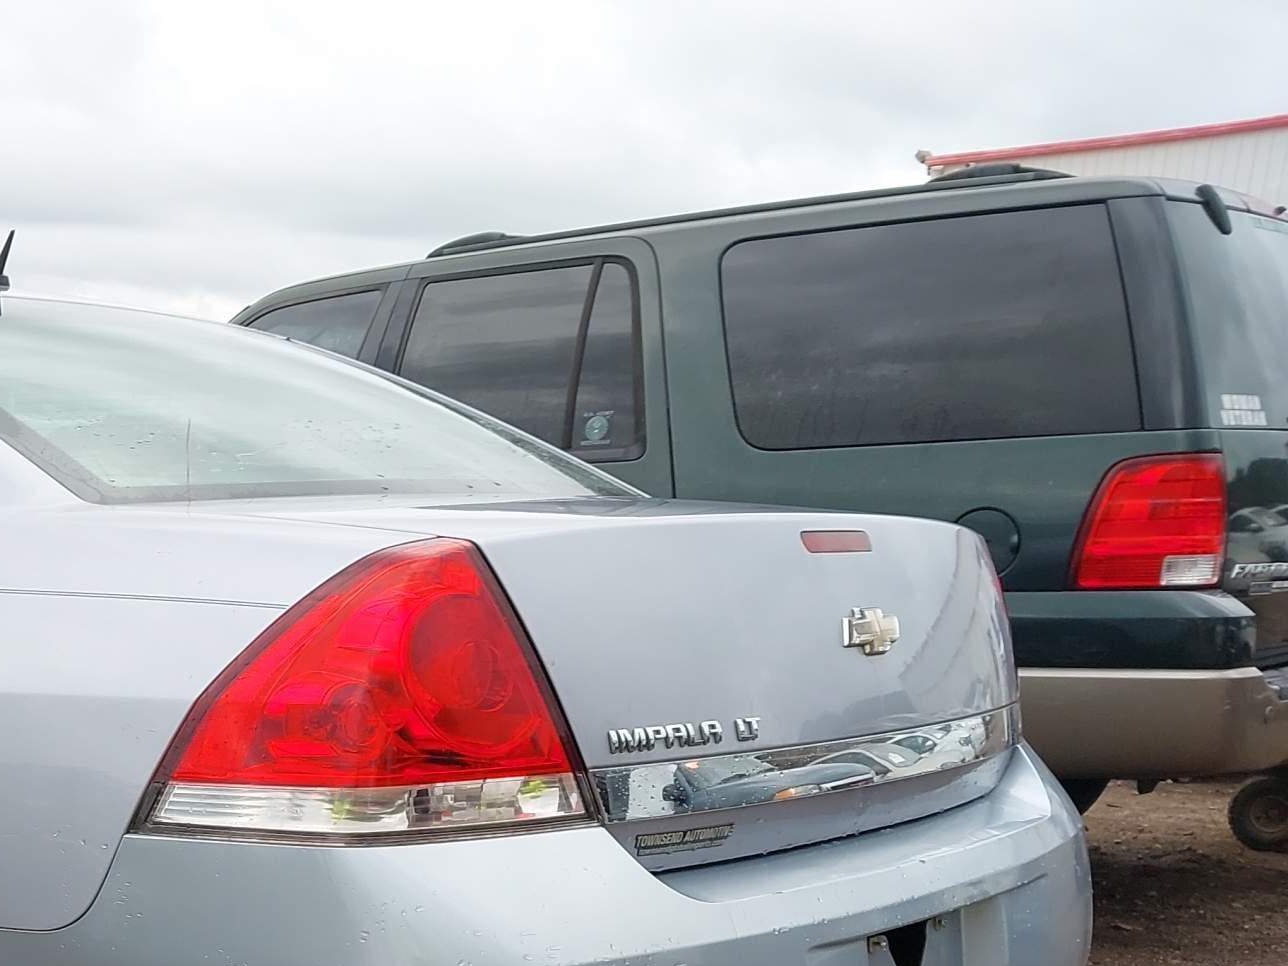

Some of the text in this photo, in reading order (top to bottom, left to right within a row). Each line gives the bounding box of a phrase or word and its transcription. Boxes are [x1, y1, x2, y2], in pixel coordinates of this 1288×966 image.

[608, 717, 761, 754] IMPALA LT
[637, 831, 684, 848] TOWNSEND
